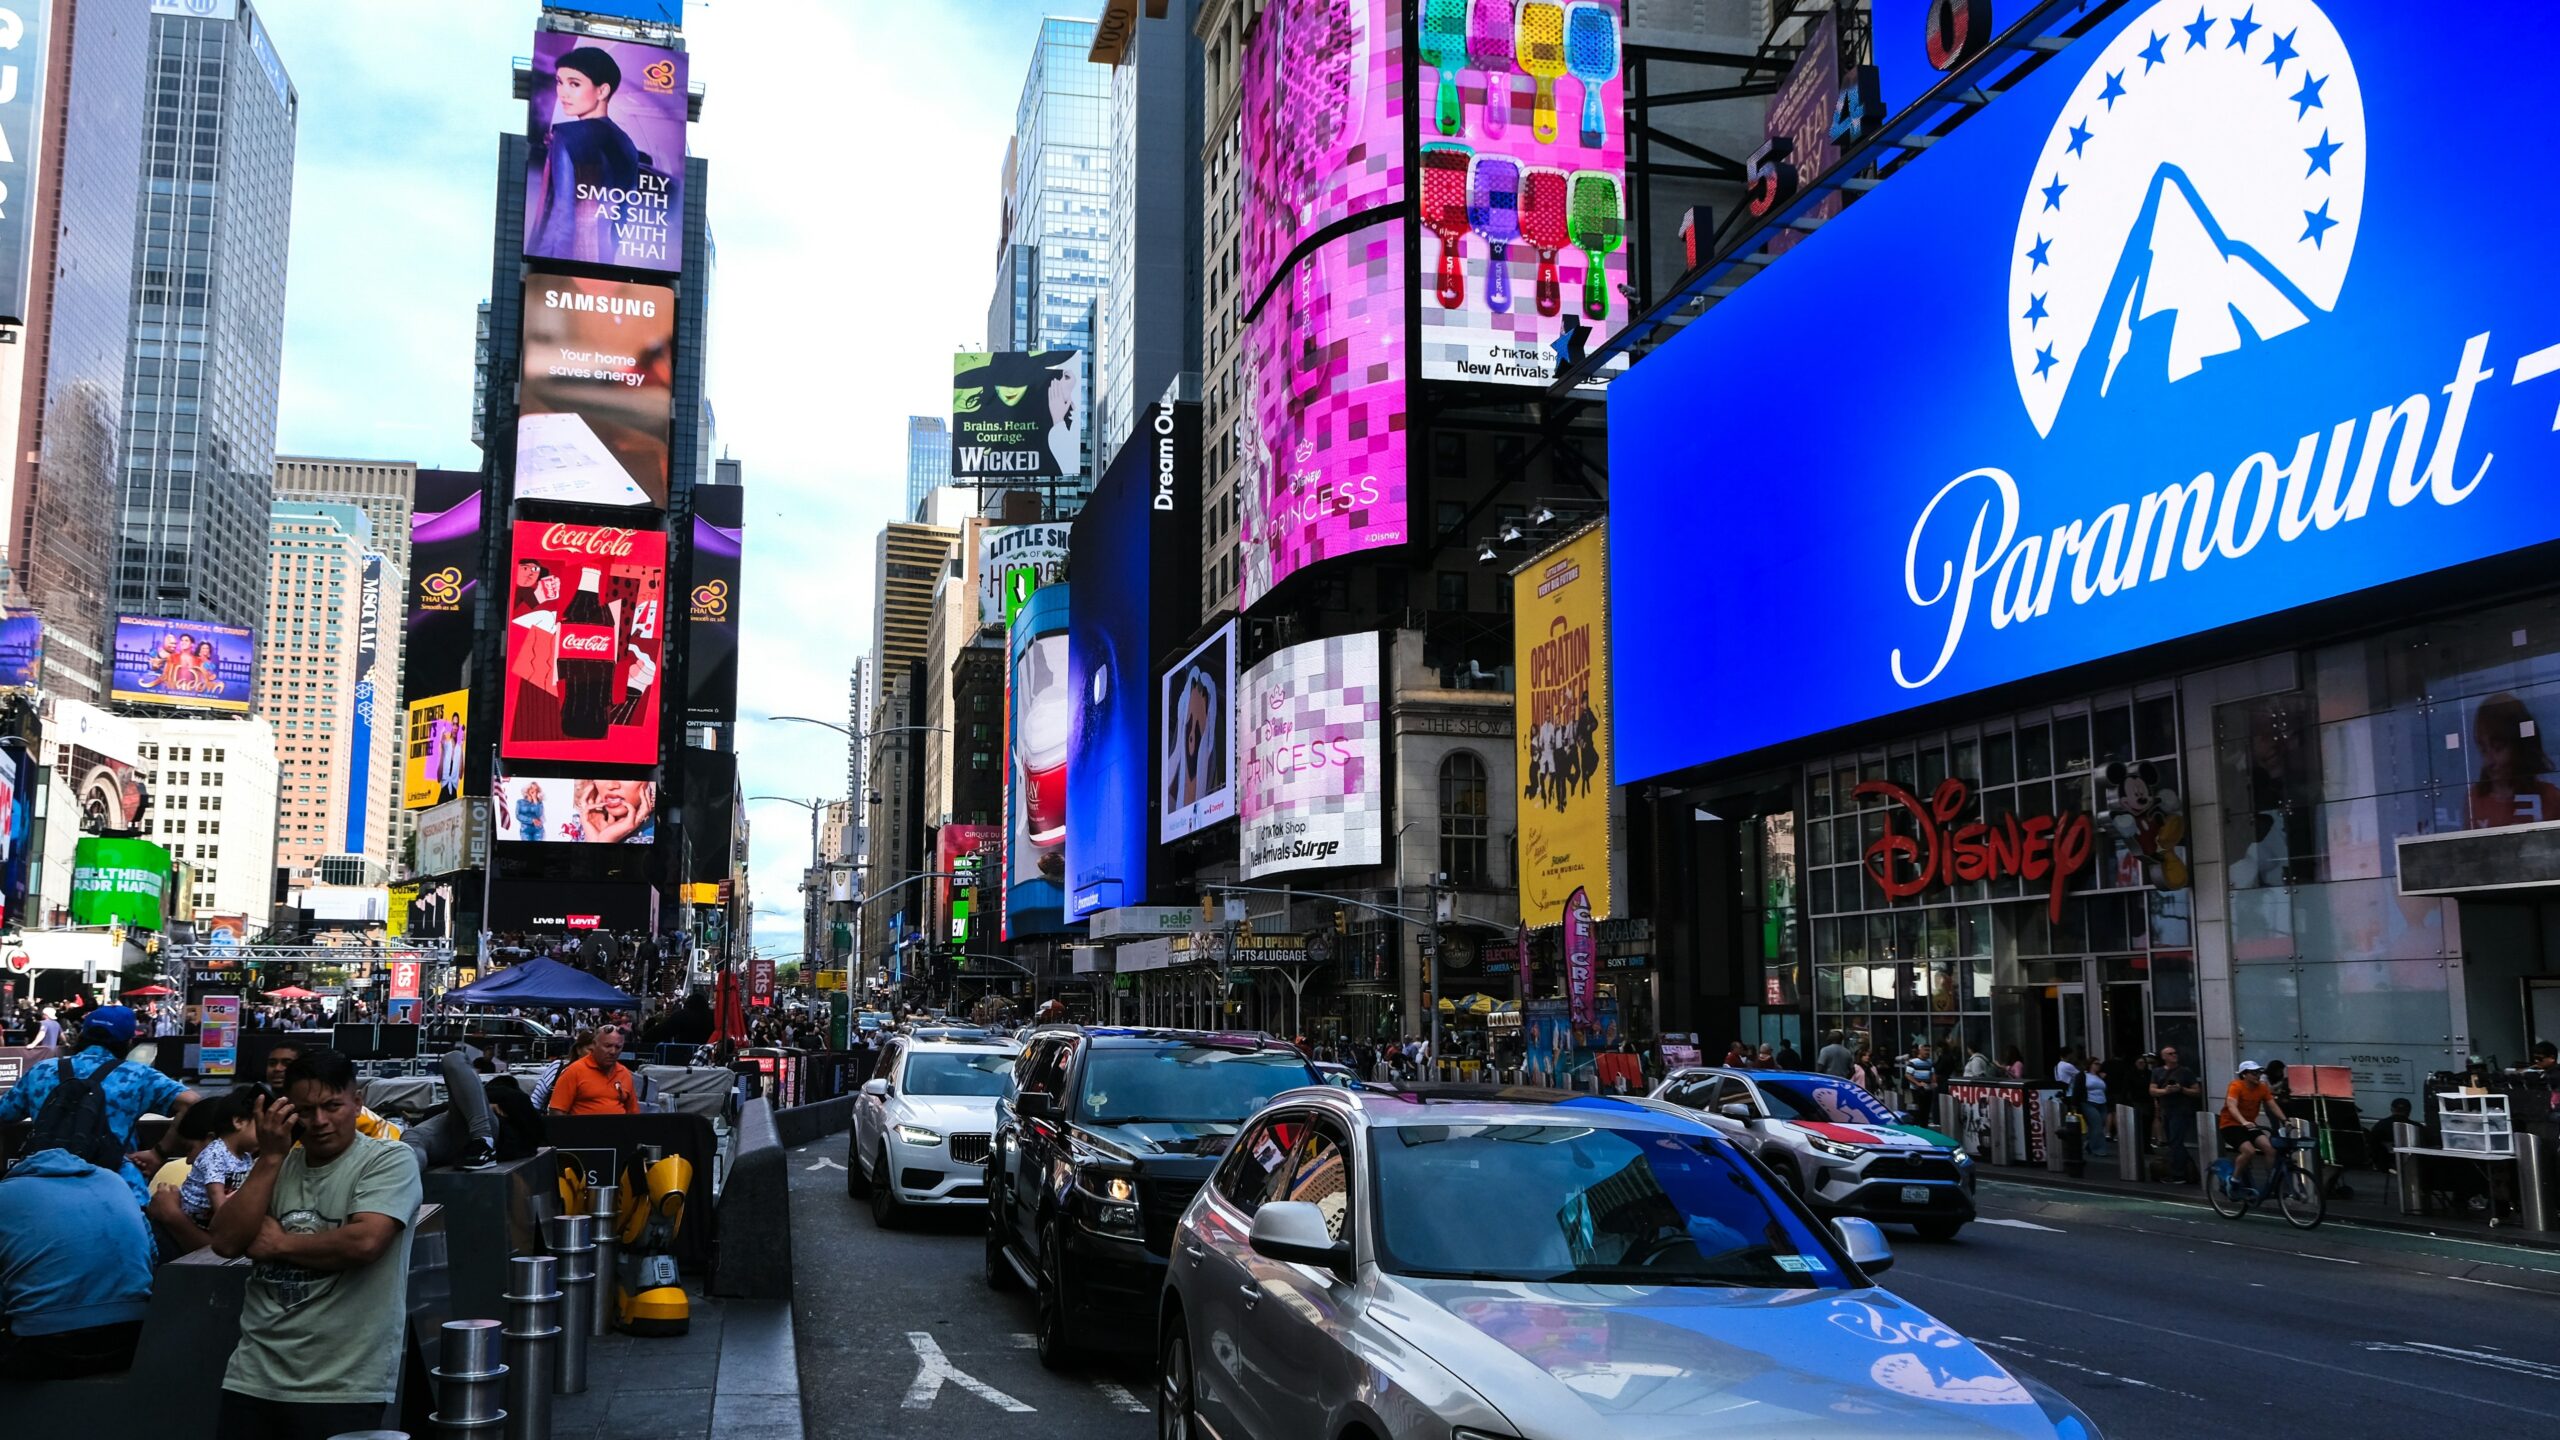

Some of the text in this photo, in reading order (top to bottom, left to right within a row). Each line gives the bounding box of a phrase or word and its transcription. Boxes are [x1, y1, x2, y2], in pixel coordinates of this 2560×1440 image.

[639, 175, 670, 192] FLY
[577, 184, 668, 209] SMOOTH
[595, 206, 668, 226] AS SILK
[615, 223, 667, 243] WITH
[619, 241, 666, 261] THAI
[545, 290, 656, 318] SAMSUNG
[560, 349, 636, 367] Your home
[1502, 348, 1539, 360] TikTok
[549, 366, 645, 387] saves energy
[1457, 360, 1548, 379] New Arrivals
[963, 421, 1039, 433] Brains. Heart.
[976, 433, 1025, 445] Courage.
[1154, 440, 1174, 511] Dream
[1270, 475, 1379, 547] PRINCESS
[1890, 330, 2495, 690] Paramount
[990, 528, 1044, 560] LITTLE
[1530, 624, 1590, 689] OPERATION
[1425, 718, 1504, 734] THE SHOW
[1246, 736, 1352, 785] PRINCESS
[470, 801, 488, 866] HELLO!
[1285, 821, 1306, 836] Shop
[1292, 839, 1339, 861] Surge
[1560, 864, 1585, 874] MUSICAL
[554, 917, 565, 925] IN
[1573, 894, 1591, 936] ICE
[1599, 918, 1649, 942] UGGAGE
[1236, 936, 1306, 949] RAND OPENING
[1486, 962, 1510, 973] CAMERA
[1607, 958, 1626, 967] SONY
[755, 962, 772, 994] tkts
[2351, 1055, 2400, 1064] VORNADO
[1949, 1085, 2023, 1108] CHICAGO
[2029, 1090, 2045, 1161] CHICAGO
